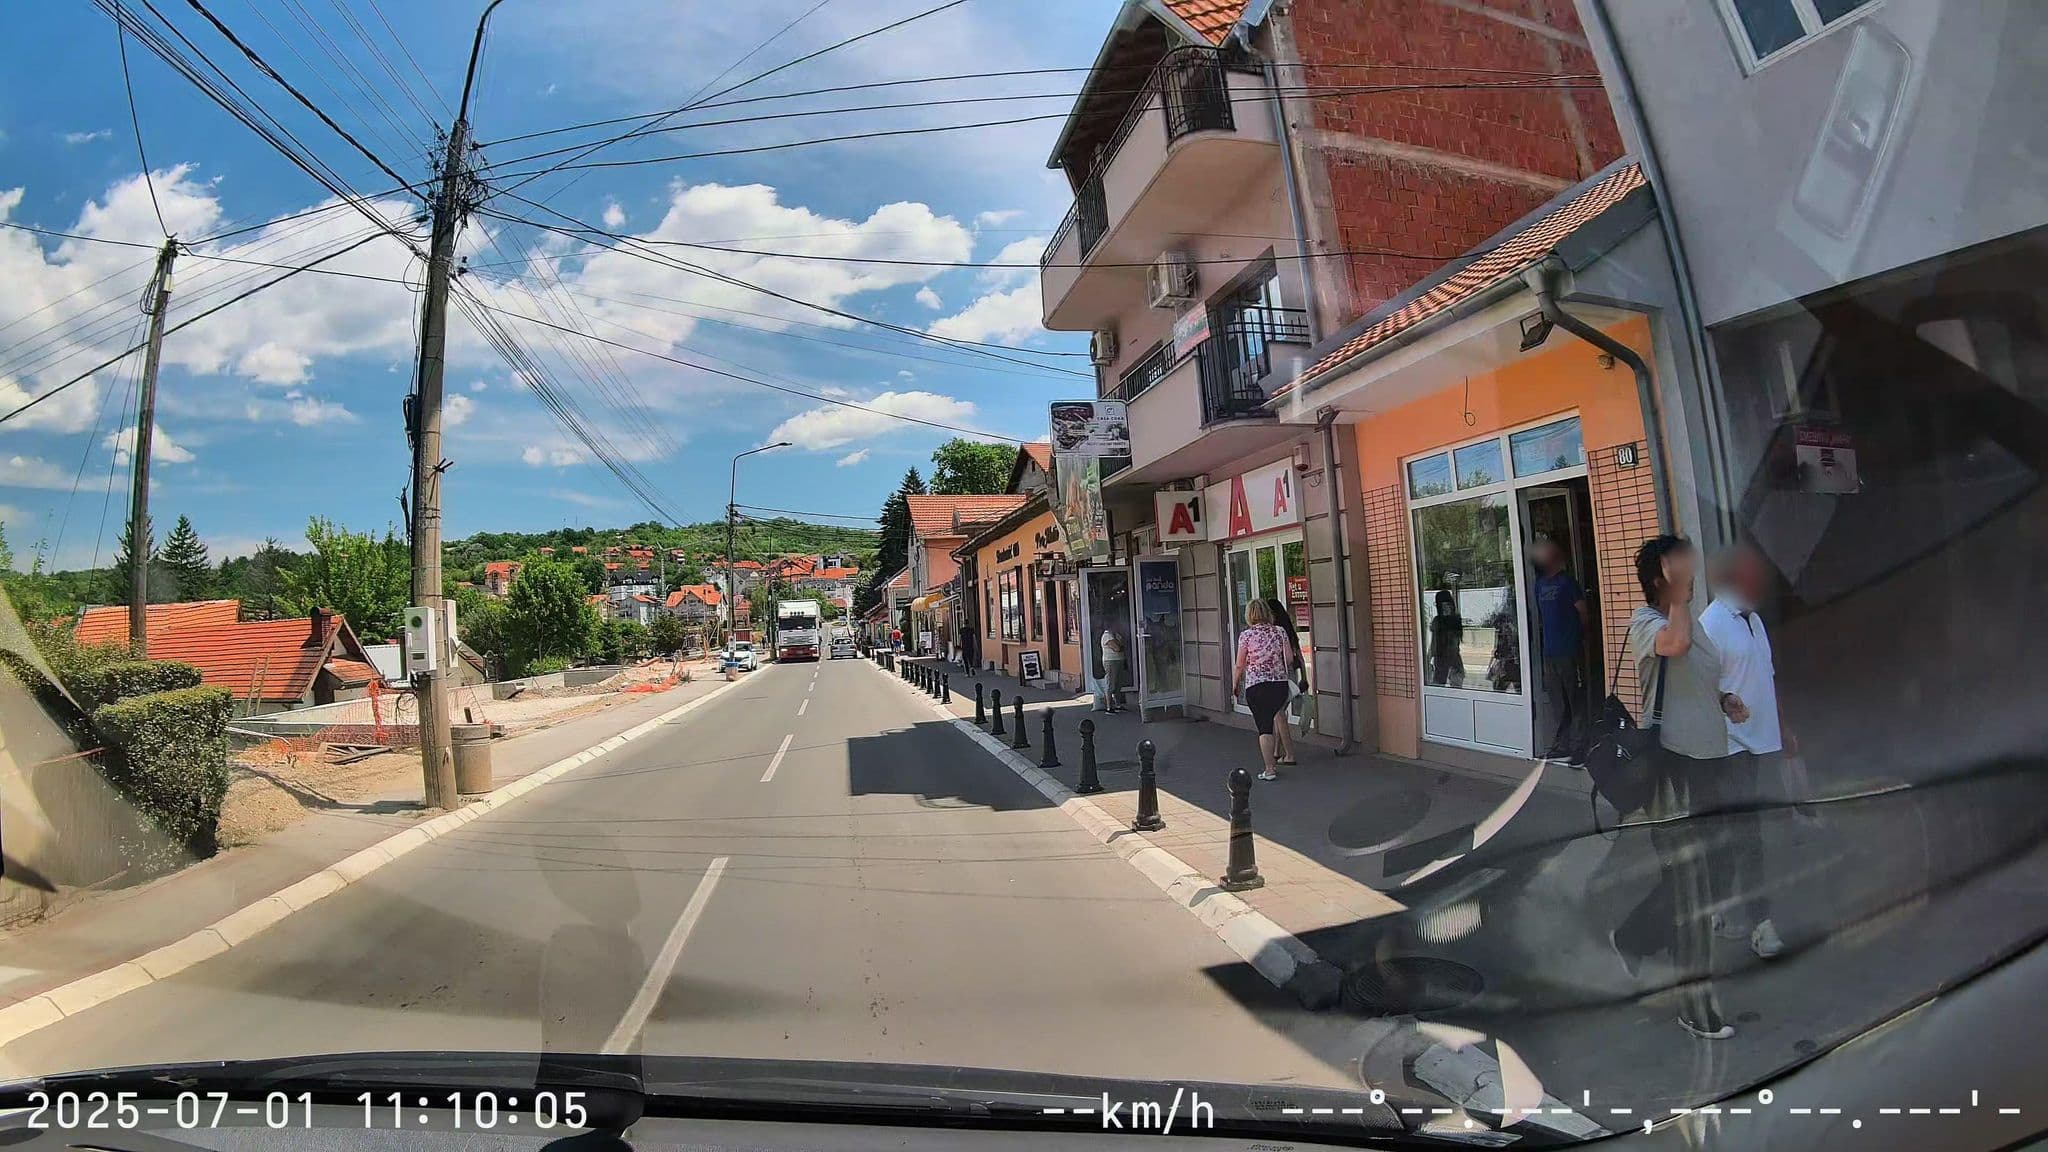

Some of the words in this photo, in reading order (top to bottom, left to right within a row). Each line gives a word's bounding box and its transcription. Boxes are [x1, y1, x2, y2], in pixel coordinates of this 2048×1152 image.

[1618, 447, 1633, 464] 80
[1273, 469, 1290, 517] A1
[1168, 496, 1201, 534] A1
